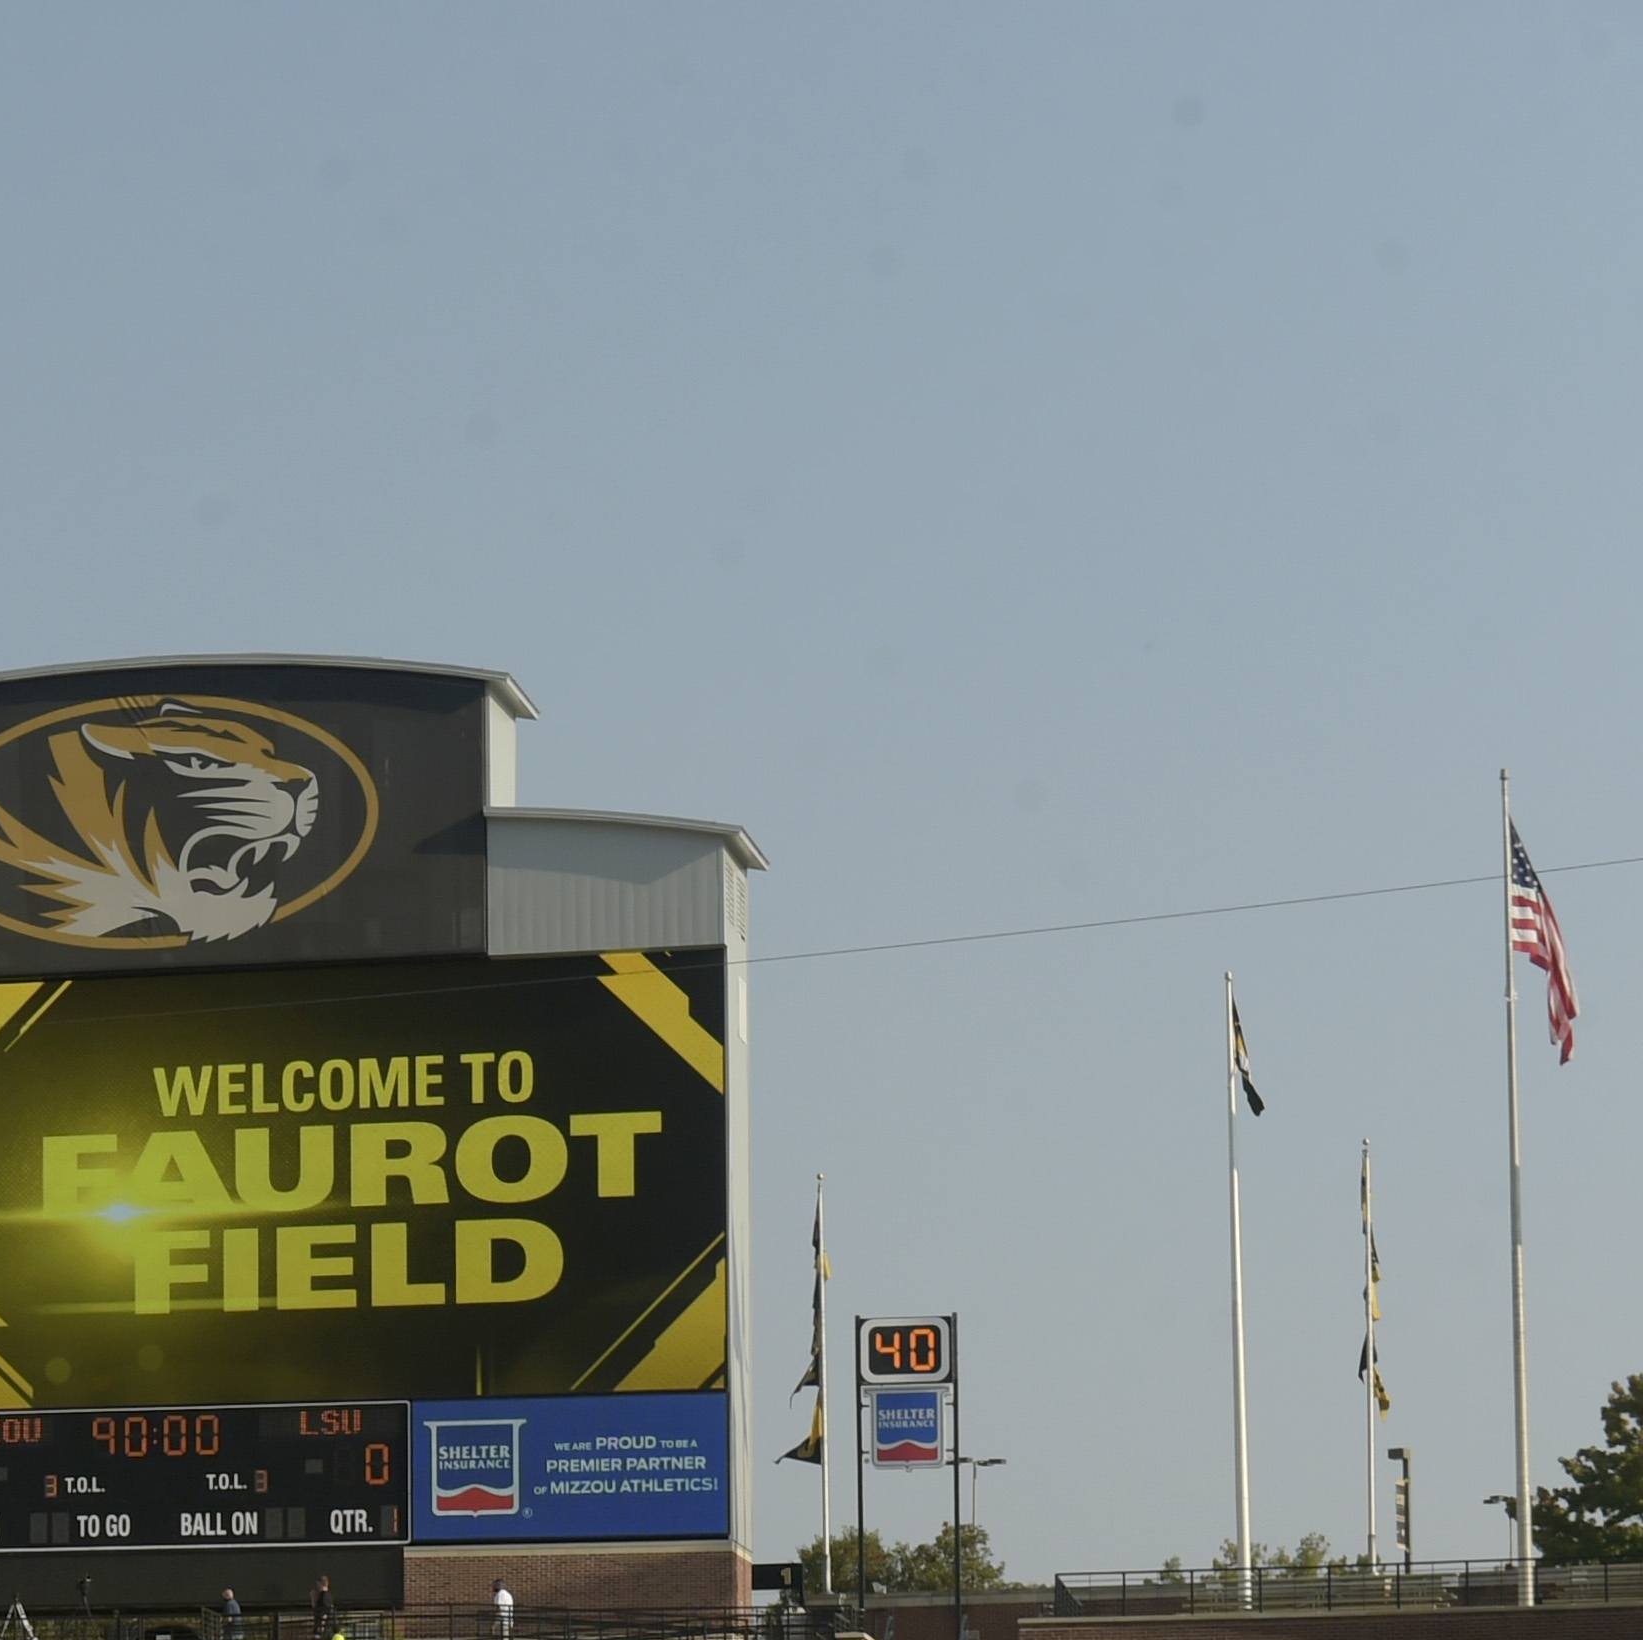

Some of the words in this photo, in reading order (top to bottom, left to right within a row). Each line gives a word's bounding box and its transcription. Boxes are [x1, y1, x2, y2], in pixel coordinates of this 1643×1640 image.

[153, 1055, 444, 1117] WELCOME
[459, 1051, 534, 1104] TO
[42, 1111, 662, 1217] FAUROT
[134, 1218, 564, 1315] FIELD
[875, 1327, 936, 1372] 40
[300, 1409, 362, 1436] LSU
[878, 1408, 935, 1421] SHELTER
[878, 1419, 935, 1430] INSURANCE
[92, 1414, 220, 1457] 90:00
[554, 1442, 571, 1451] WE
[572, 1441, 592, 1451] ARE
[596, 1436, 656, 1450] PROUD
[660, 1440, 674, 1449] TO
[675, 1439, 689, 1448] BE
[689, 1439, 697, 1448] A
[365, 1443, 390, 1485] 0
[439, 1445, 510, 1460] SHELTER
[439, 1459, 510, 1470] INSURANCE
[546, 1458, 622, 1473] PREMIER
[626, 1456, 706, 1471] PARTNER
[45, 1475, 58, 1498] 3
[65, 1477, 105, 1494] T.O.L.
[206, 1473, 248, 1490] T.O.L.
[534, 1485, 548, 1495] OF
[550, 1480, 616, 1495] MIZZOU
[619, 1477, 718, 1493] ATHLETICS!
[77, 1515, 100, 1537] TO
[105, 1514, 131, 1537] GO
[180, 1512, 227, 1536] BALL
[231, 1511, 258, 1535] ON
[330, 1509, 373, 1535] QTR.
